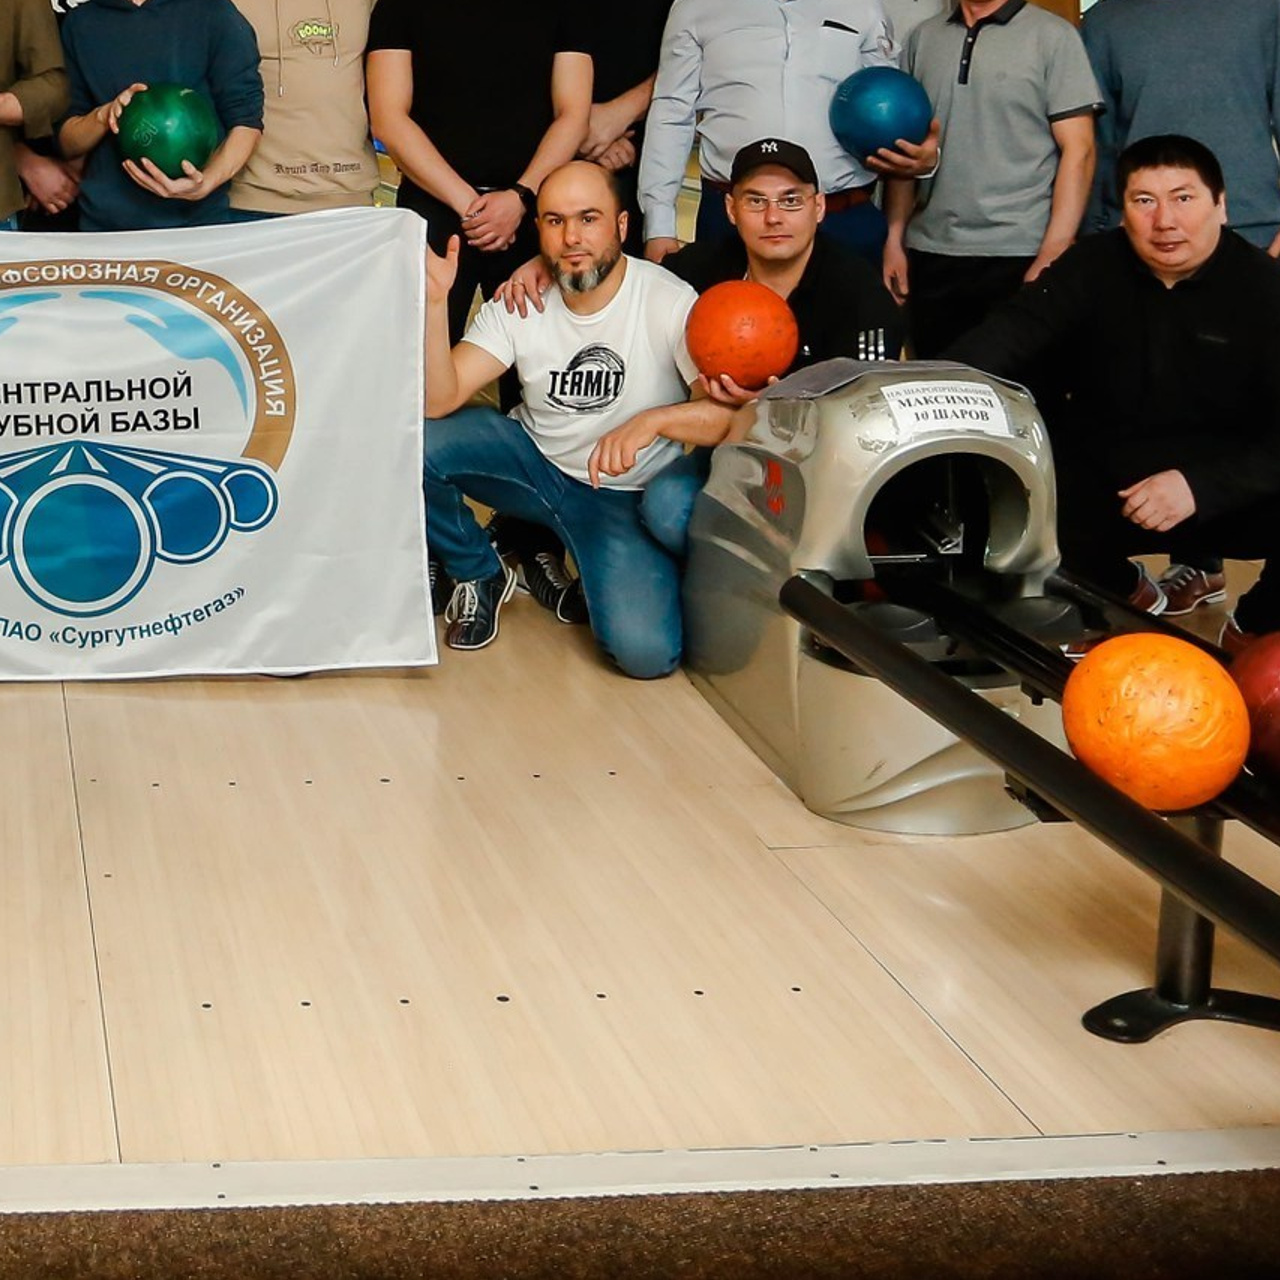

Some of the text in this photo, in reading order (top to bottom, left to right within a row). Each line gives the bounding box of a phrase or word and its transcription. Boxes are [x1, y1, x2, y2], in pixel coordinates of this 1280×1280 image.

[165, 272, 286, 417] ОРГАНИЗАЦИЯ
[548, 370, 624, 397] TERMIT
[898, 395, 994, 408] МАКСИМУМ
[914, 408, 990, 421] 10 ШАРОВ
[111, 407, 200, 432] БАЗЫ
[49, 586, 246, 648] «Сургутнефтегаз»
